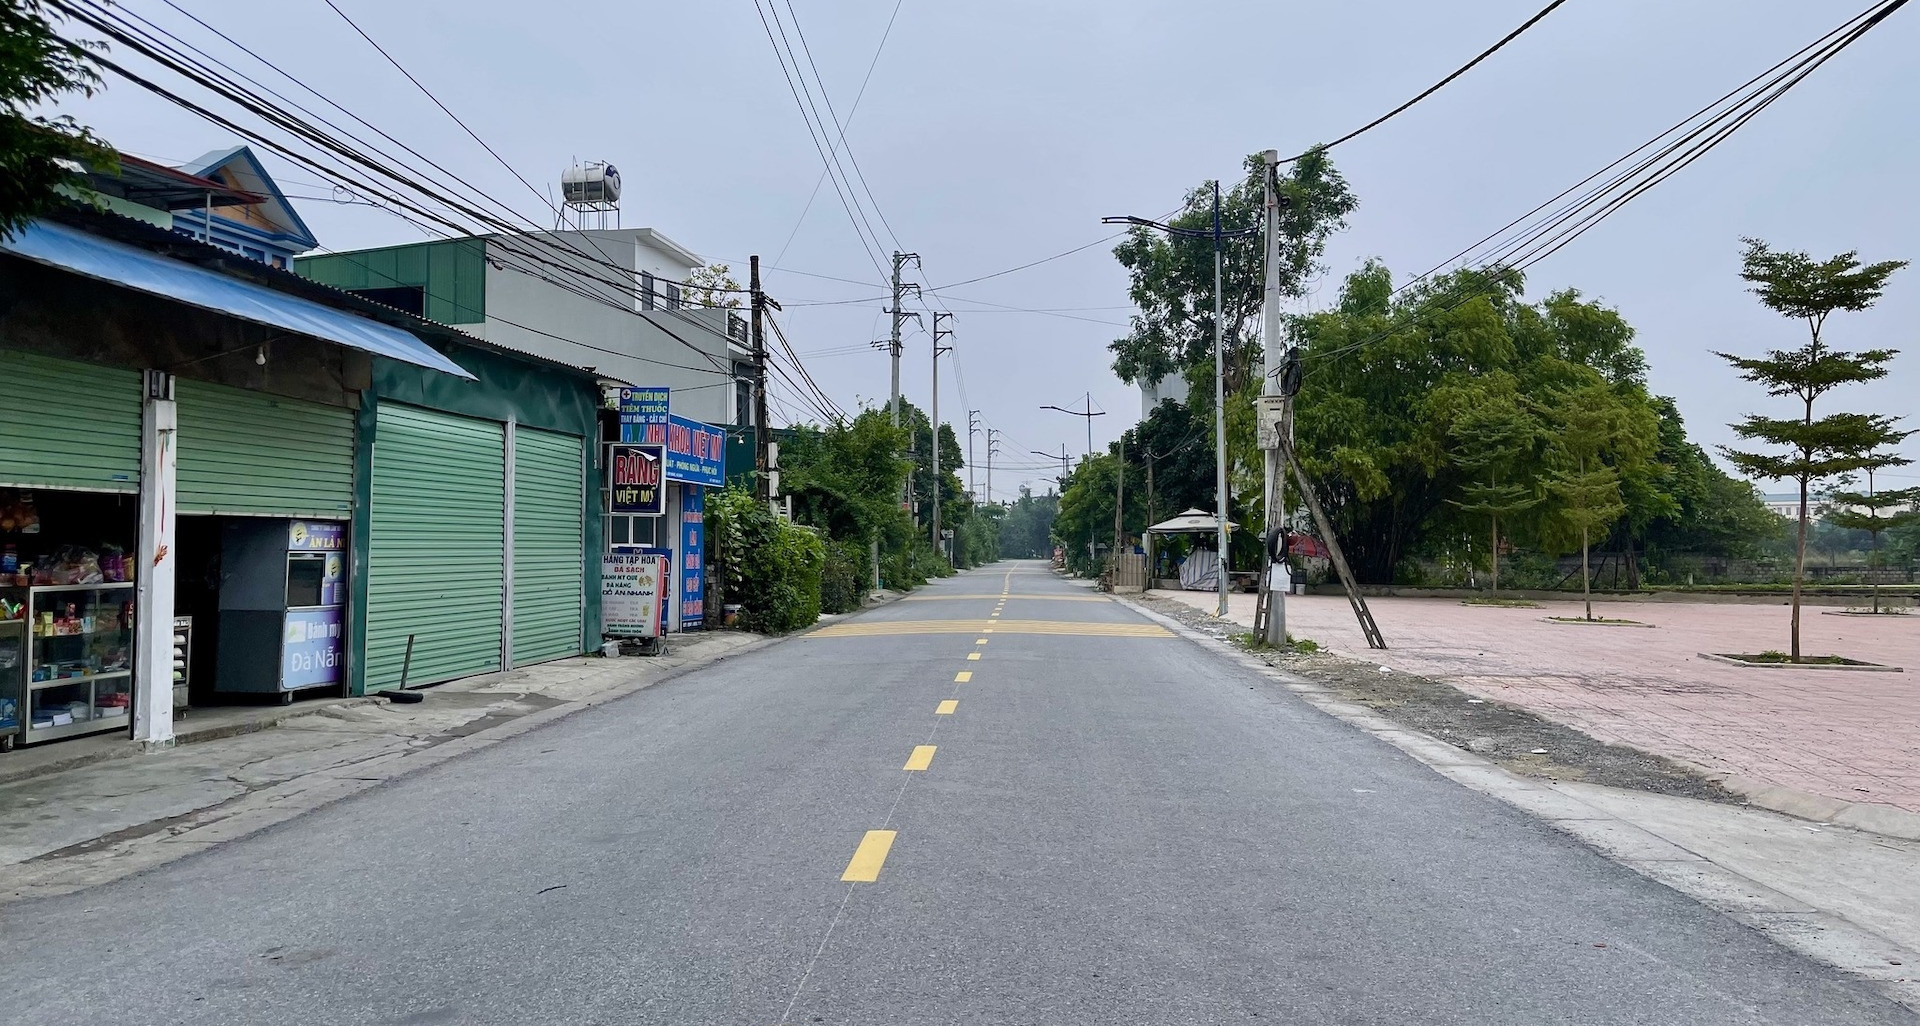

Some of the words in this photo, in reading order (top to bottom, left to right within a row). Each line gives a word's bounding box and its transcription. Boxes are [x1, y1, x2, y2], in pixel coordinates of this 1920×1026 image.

[621, 403, 640, 412] TIÊM
[641, 402, 667, 412] THUỐC
[668, 422, 691, 456] KHOA
[692, 426, 710, 464] VIỆT
[616, 449, 659, 487] RĂNG
[616, 486, 638, 504] VIỆT
[626, 556, 640, 566] TẠP
[307, 621, 328, 640] Bánh
[292, 651, 311, 672] Đà
